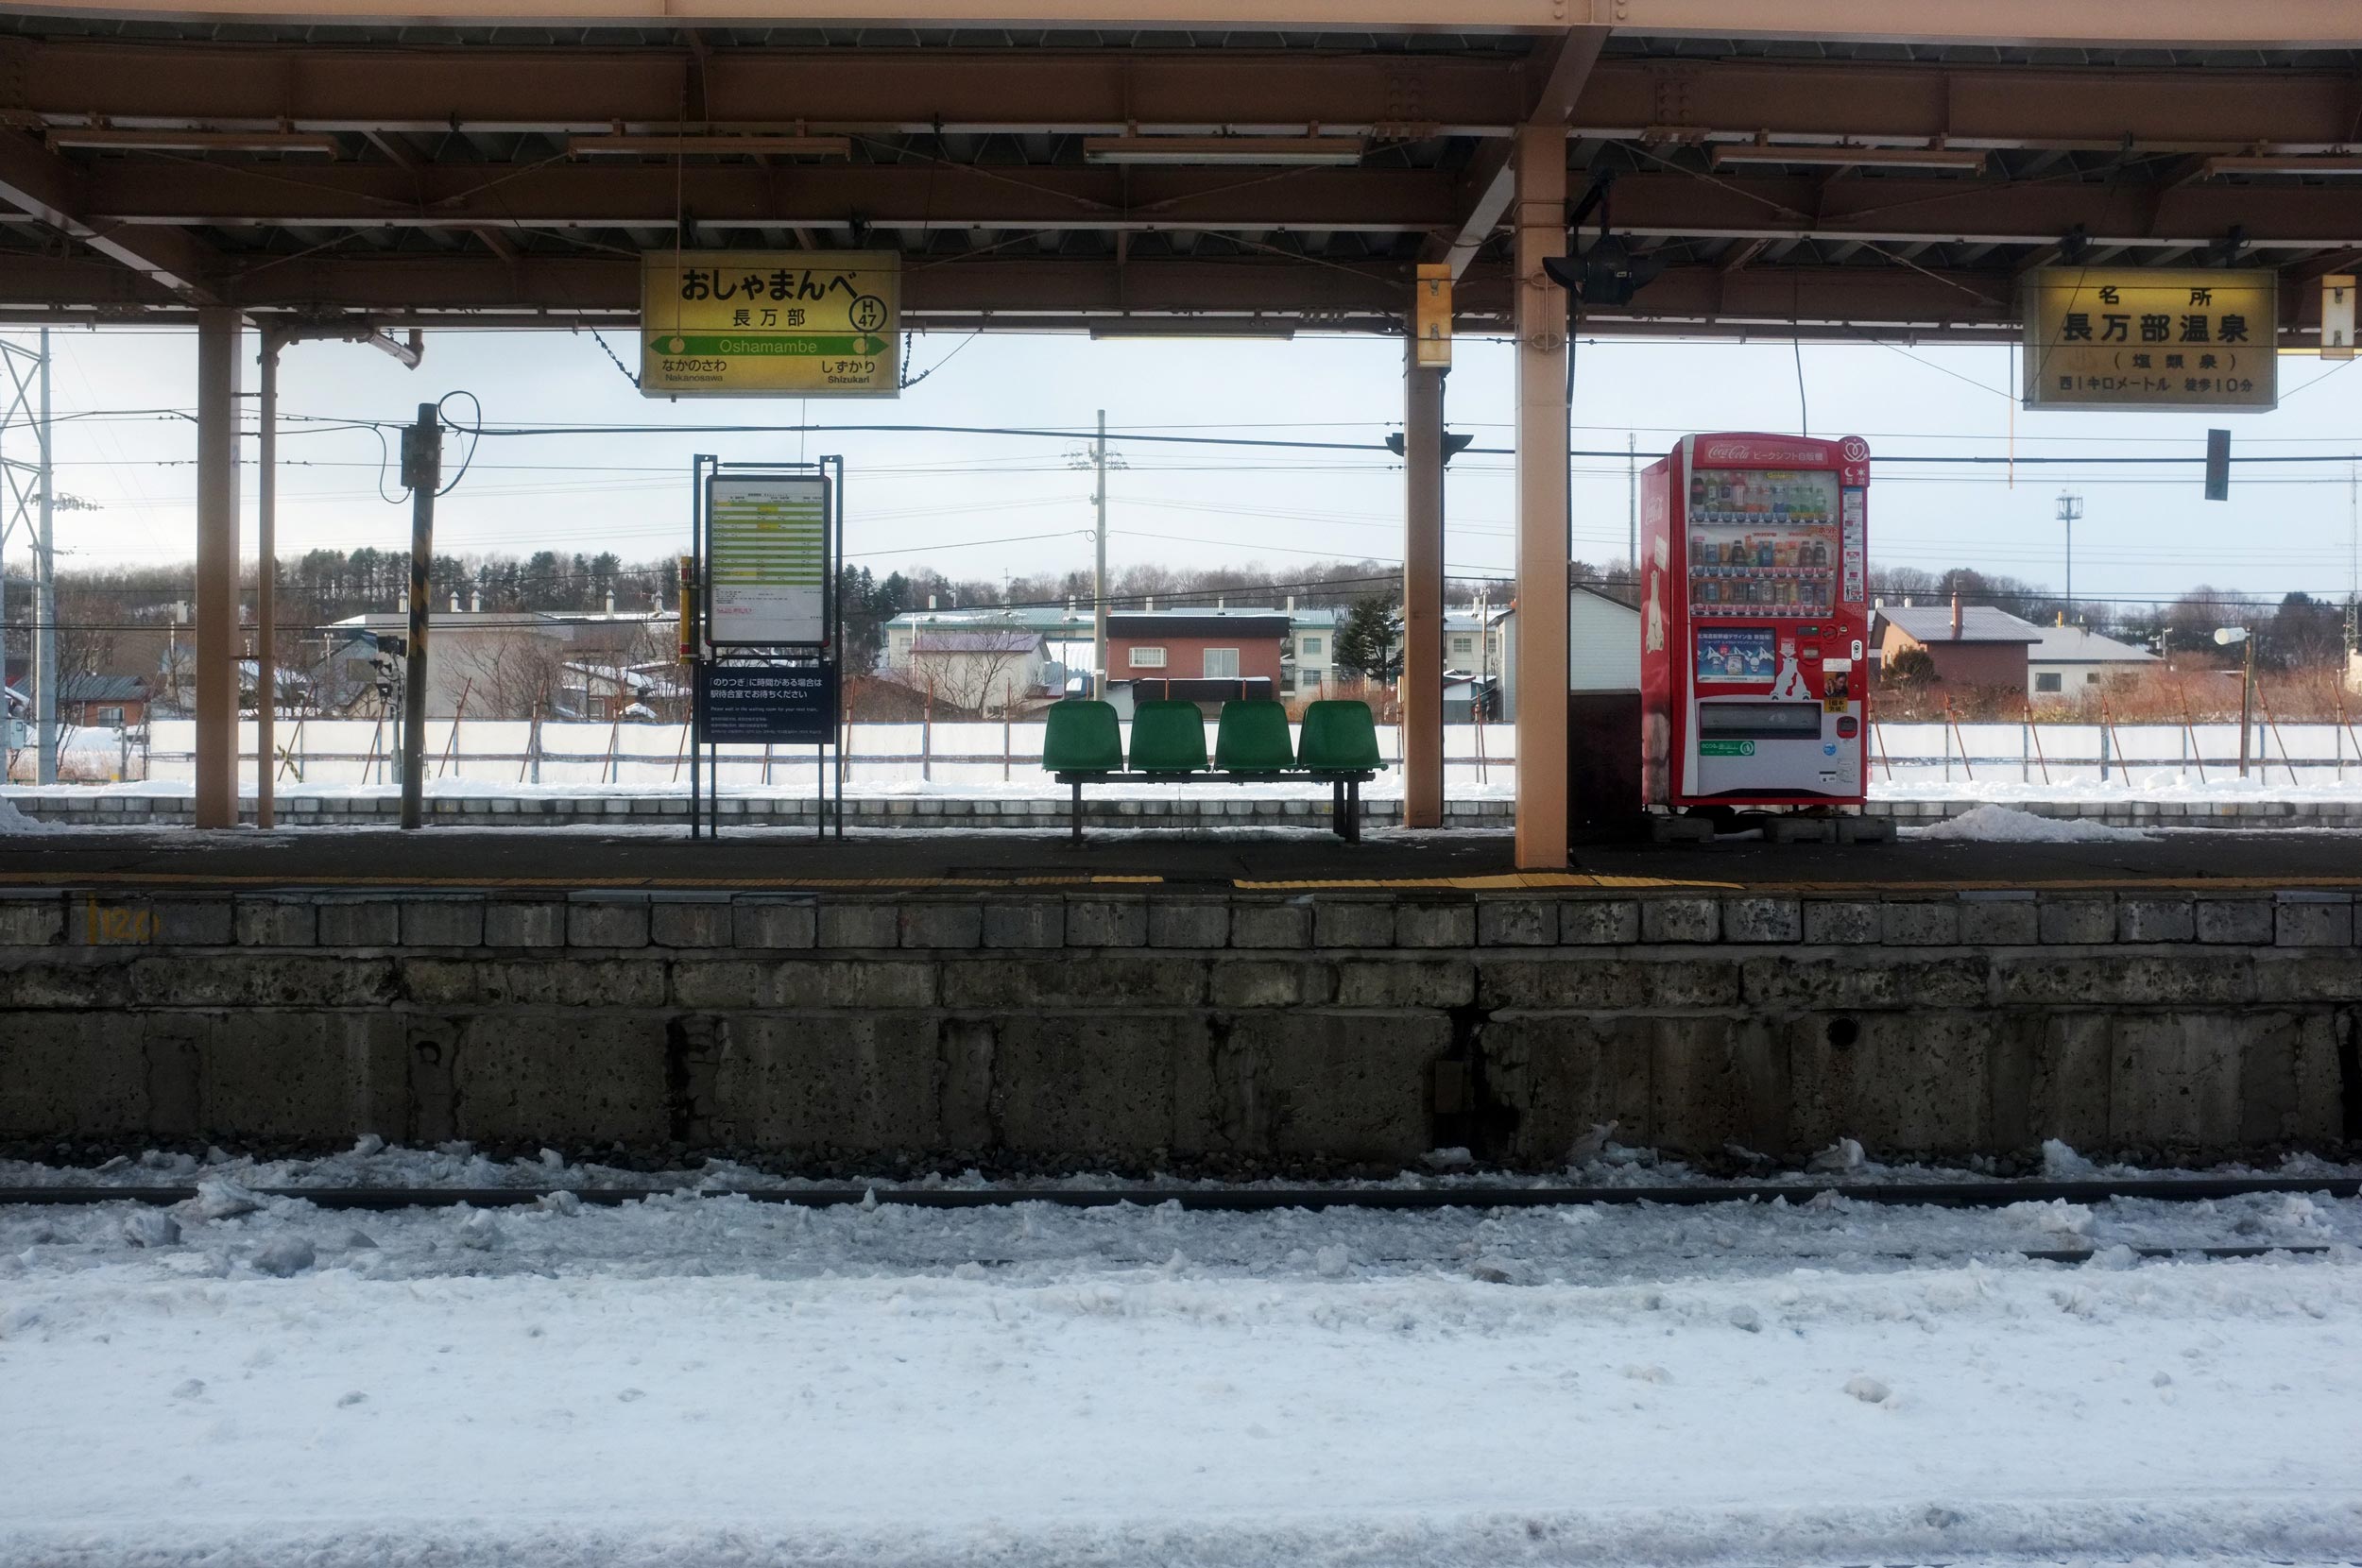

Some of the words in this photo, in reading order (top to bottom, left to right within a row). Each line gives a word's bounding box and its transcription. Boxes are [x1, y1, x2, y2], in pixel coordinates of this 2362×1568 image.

[681, 268, 858, 301] おしゃまんべ
[862, 300, 874, 314] H
[733, 308, 806, 327] 長万部
[858, 315, 879, 327] 47
[2062, 313, 2249, 343] 長万部温泉
[719, 339, 817, 353] Oshamambe
[662, 359, 727, 372] なかのさわ
[821, 360, 875, 374] しずかり
[665, 373, 724, 382] Nakanosawa
[828, 375, 870, 383] Shizukari
[1708, 444, 1750, 459] Coca-Cola
[710, 690, 808, 699] 駅待合室でお待ちください
